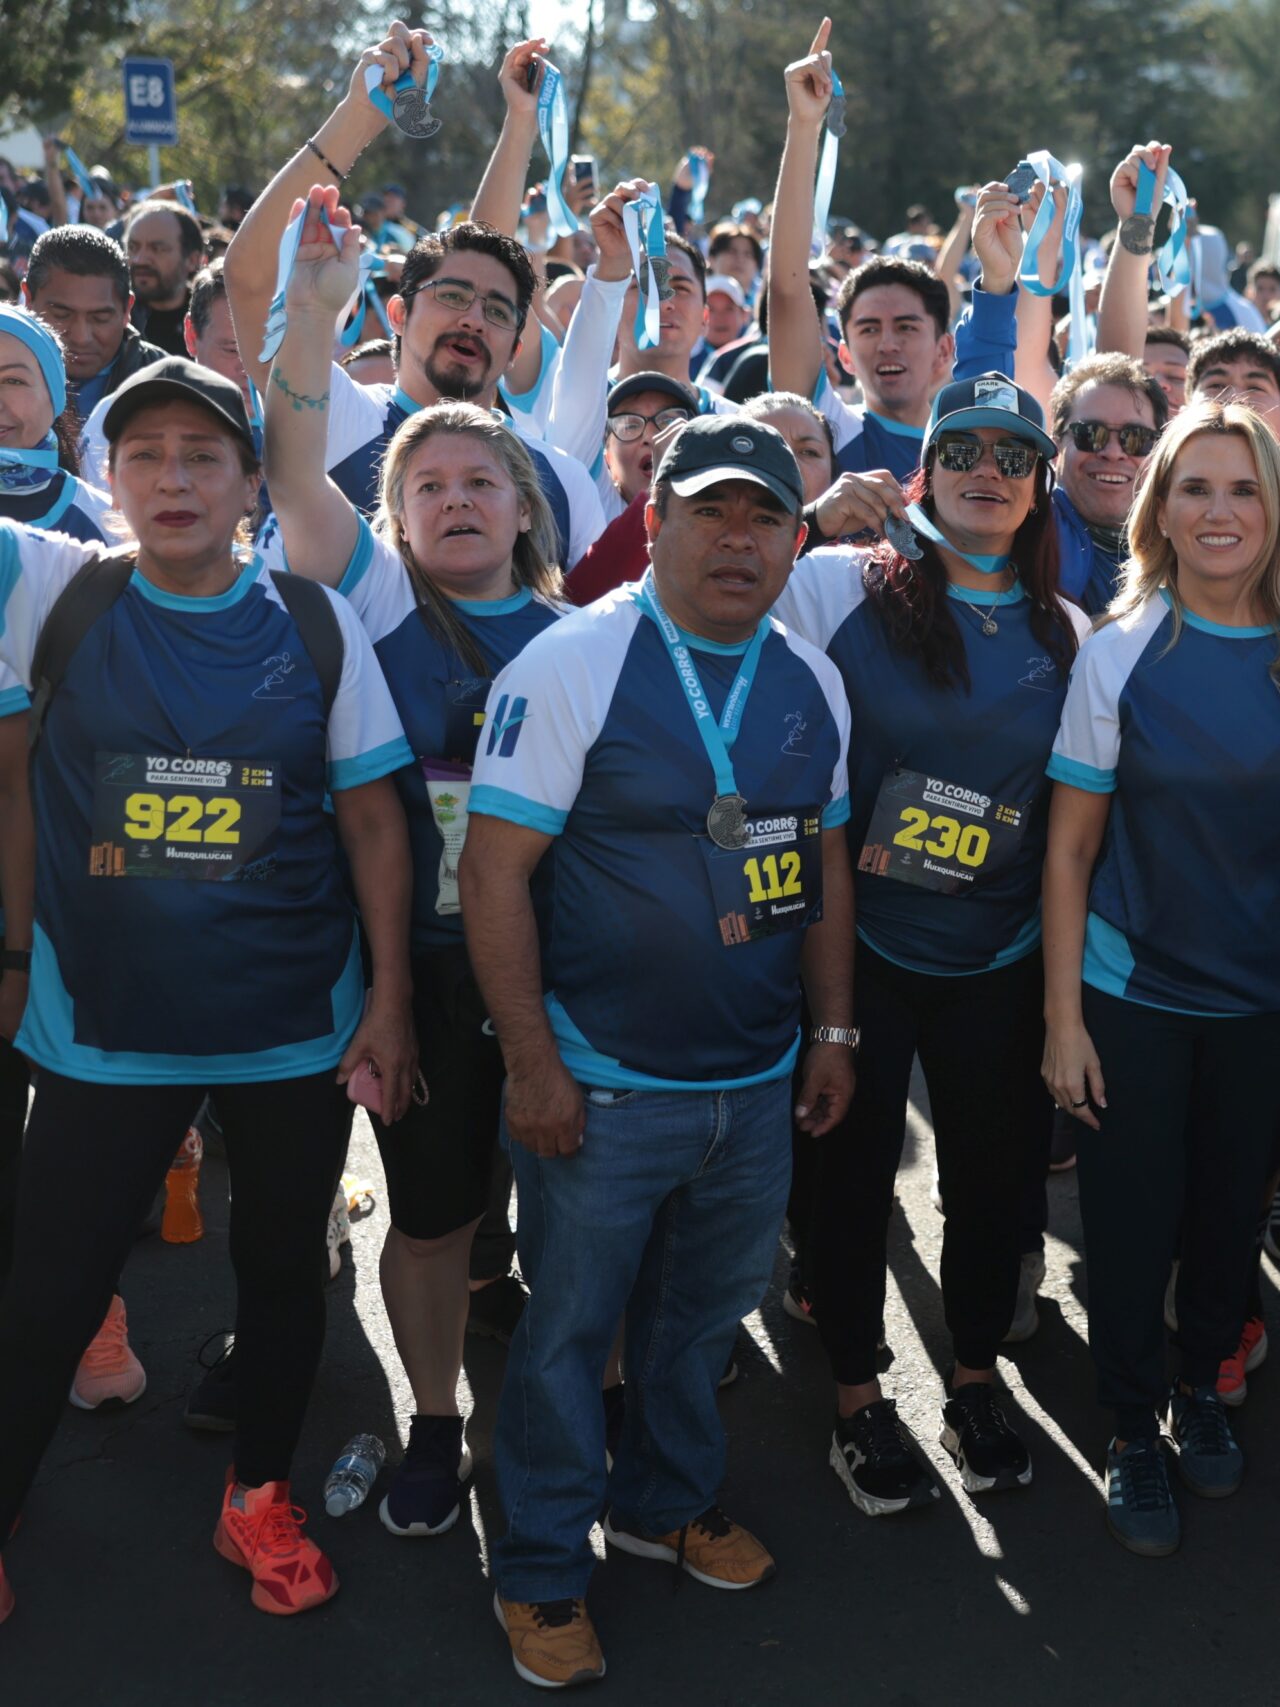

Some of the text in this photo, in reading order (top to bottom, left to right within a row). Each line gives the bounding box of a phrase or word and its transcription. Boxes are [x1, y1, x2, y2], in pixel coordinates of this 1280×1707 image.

[130, 75, 165, 107] E8
[693, 700, 710, 719] YO
[146, 757, 168, 771] YO
[170, 776, 204, 784] SENTIRME
[241, 768, 266, 777] 3 KM
[241, 777, 266, 786] 5 KM
[925, 778, 944, 793] YO
[925, 793, 982, 815] PARA SENTIRME VIVO
[997, 804, 1016, 816] 3 KM
[124, 793, 242, 844] 922
[995, 812, 1014, 824] 5 KM
[893, 806, 991, 868] 230
[743, 851, 802, 903] 112
